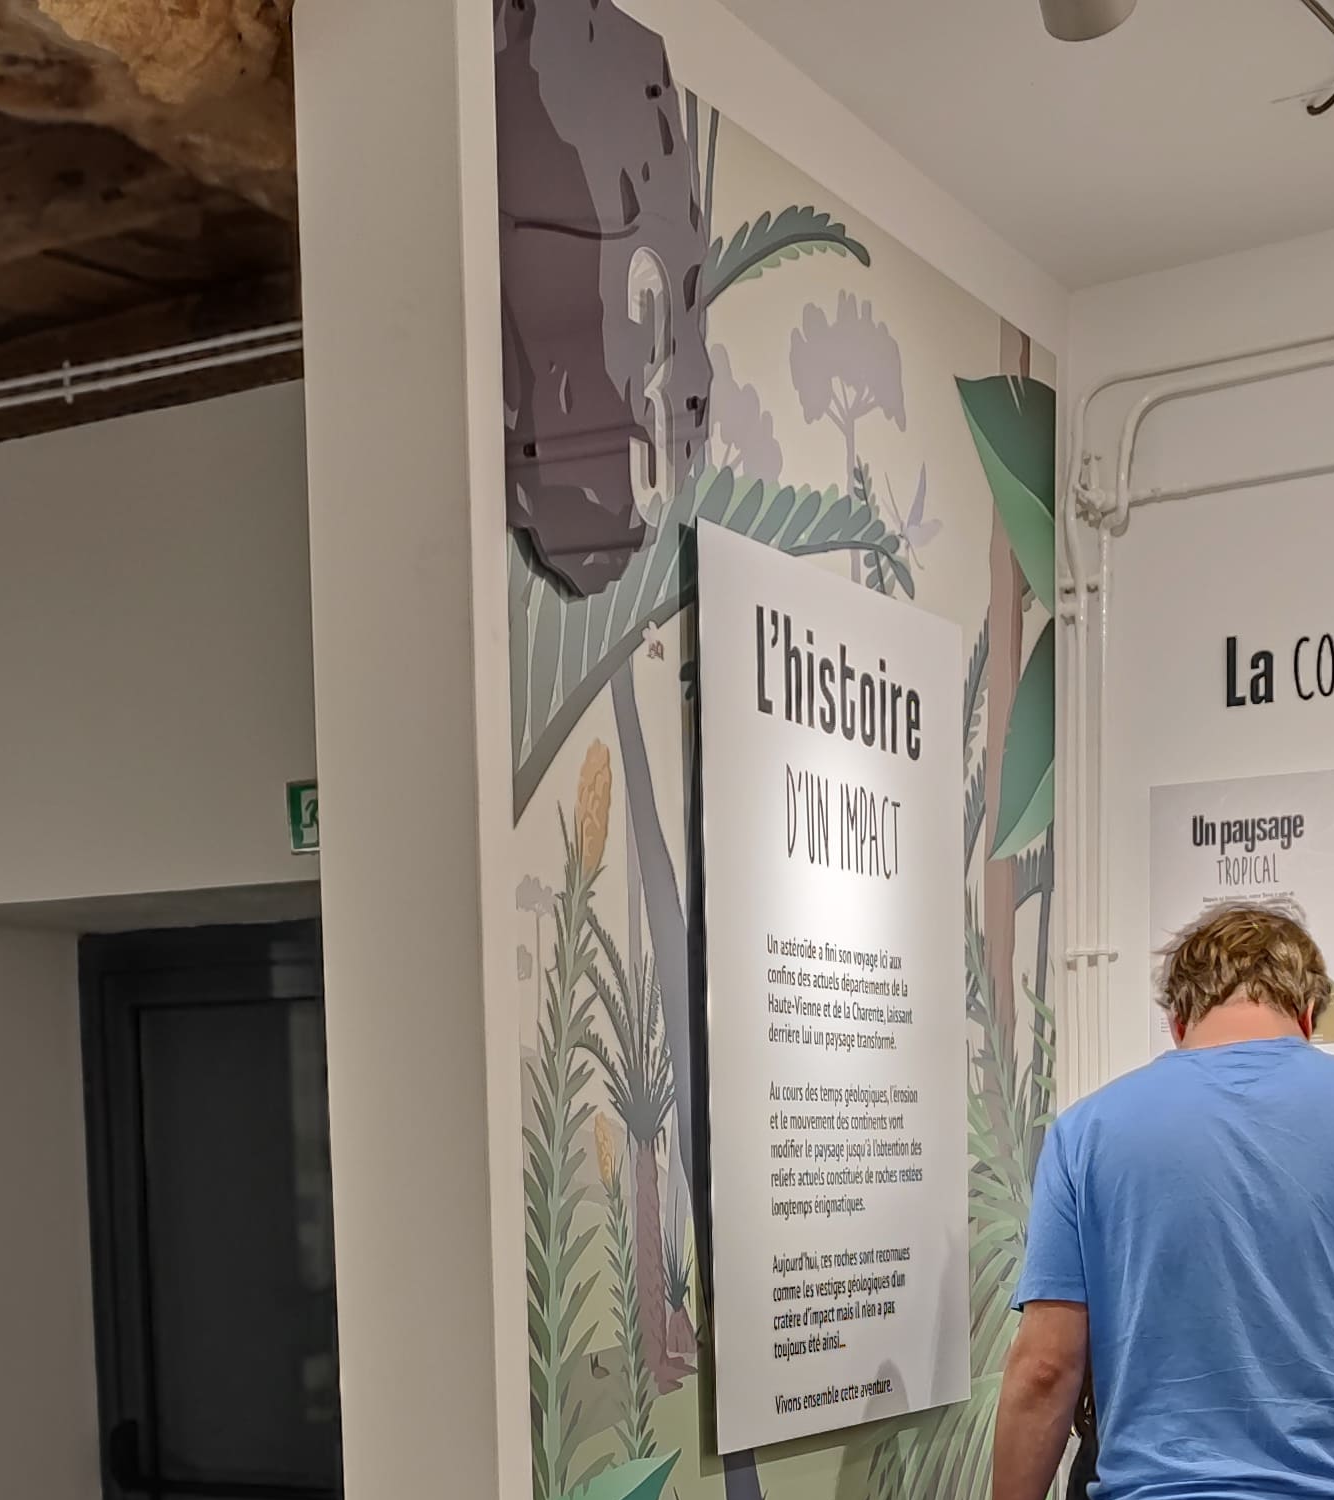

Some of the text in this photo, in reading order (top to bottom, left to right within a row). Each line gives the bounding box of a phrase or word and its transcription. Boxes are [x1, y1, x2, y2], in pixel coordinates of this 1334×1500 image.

[756, 604, 921, 761] L'histoire
[1226, 636, 1274, 707] La
[786, 763, 900, 880] D'UN IMPACT
[1192, 814, 1304, 855] Un paysage
[1216, 852, 1279, 886] TROPICAL
[767, 934, 778, 954] Un
[781, 937, 816, 959] astéroïde
[819, 946, 823, 960] a
[825, 943, 837, 962] fini
[839, 948, 851, 964] son
[854, 950, 878, 972] voyage
[889, 953, 902, 970] aux
[768, 966, 908, 997] confins des actuels départements de la
[768, 993, 913, 1025] Haute-Vienne et de la Charente, laissant
[768, 1023, 897, 1052] derrière lui un paysage transformé.
[770, 1081, 918, 1107] Au cours des temps géologiques, l'érosion
[770, 1111, 903, 1130] et le mouvement des continents vont
[771, 1138, 922, 1163] modifier le paysage jusqu'à l'obtention des
[771, 1168, 796, 1187] reliefs
[798, 1169, 825, 1186] actuels
[826, 1166, 863, 1184] constitués
[865, 1165, 874, 1183] de
[875, 1166, 897, 1183] roches
[771, 1194, 865, 1220] longtemps énigmatiques.
[773, 1247, 910, 1277] Aujourd'hui, ces roches sont reconnues
[773, 1270, 905, 1302] comme les vestiges géologiques d'un
[774, 1300, 895, 1330] cratère d'impact mais il n'en a pas
[774, 1338, 806, 1361] toujours
[809, 1333, 820, 1352] été
[775, 1377, 893, 1414] Vivons ensemble cette aventure.
